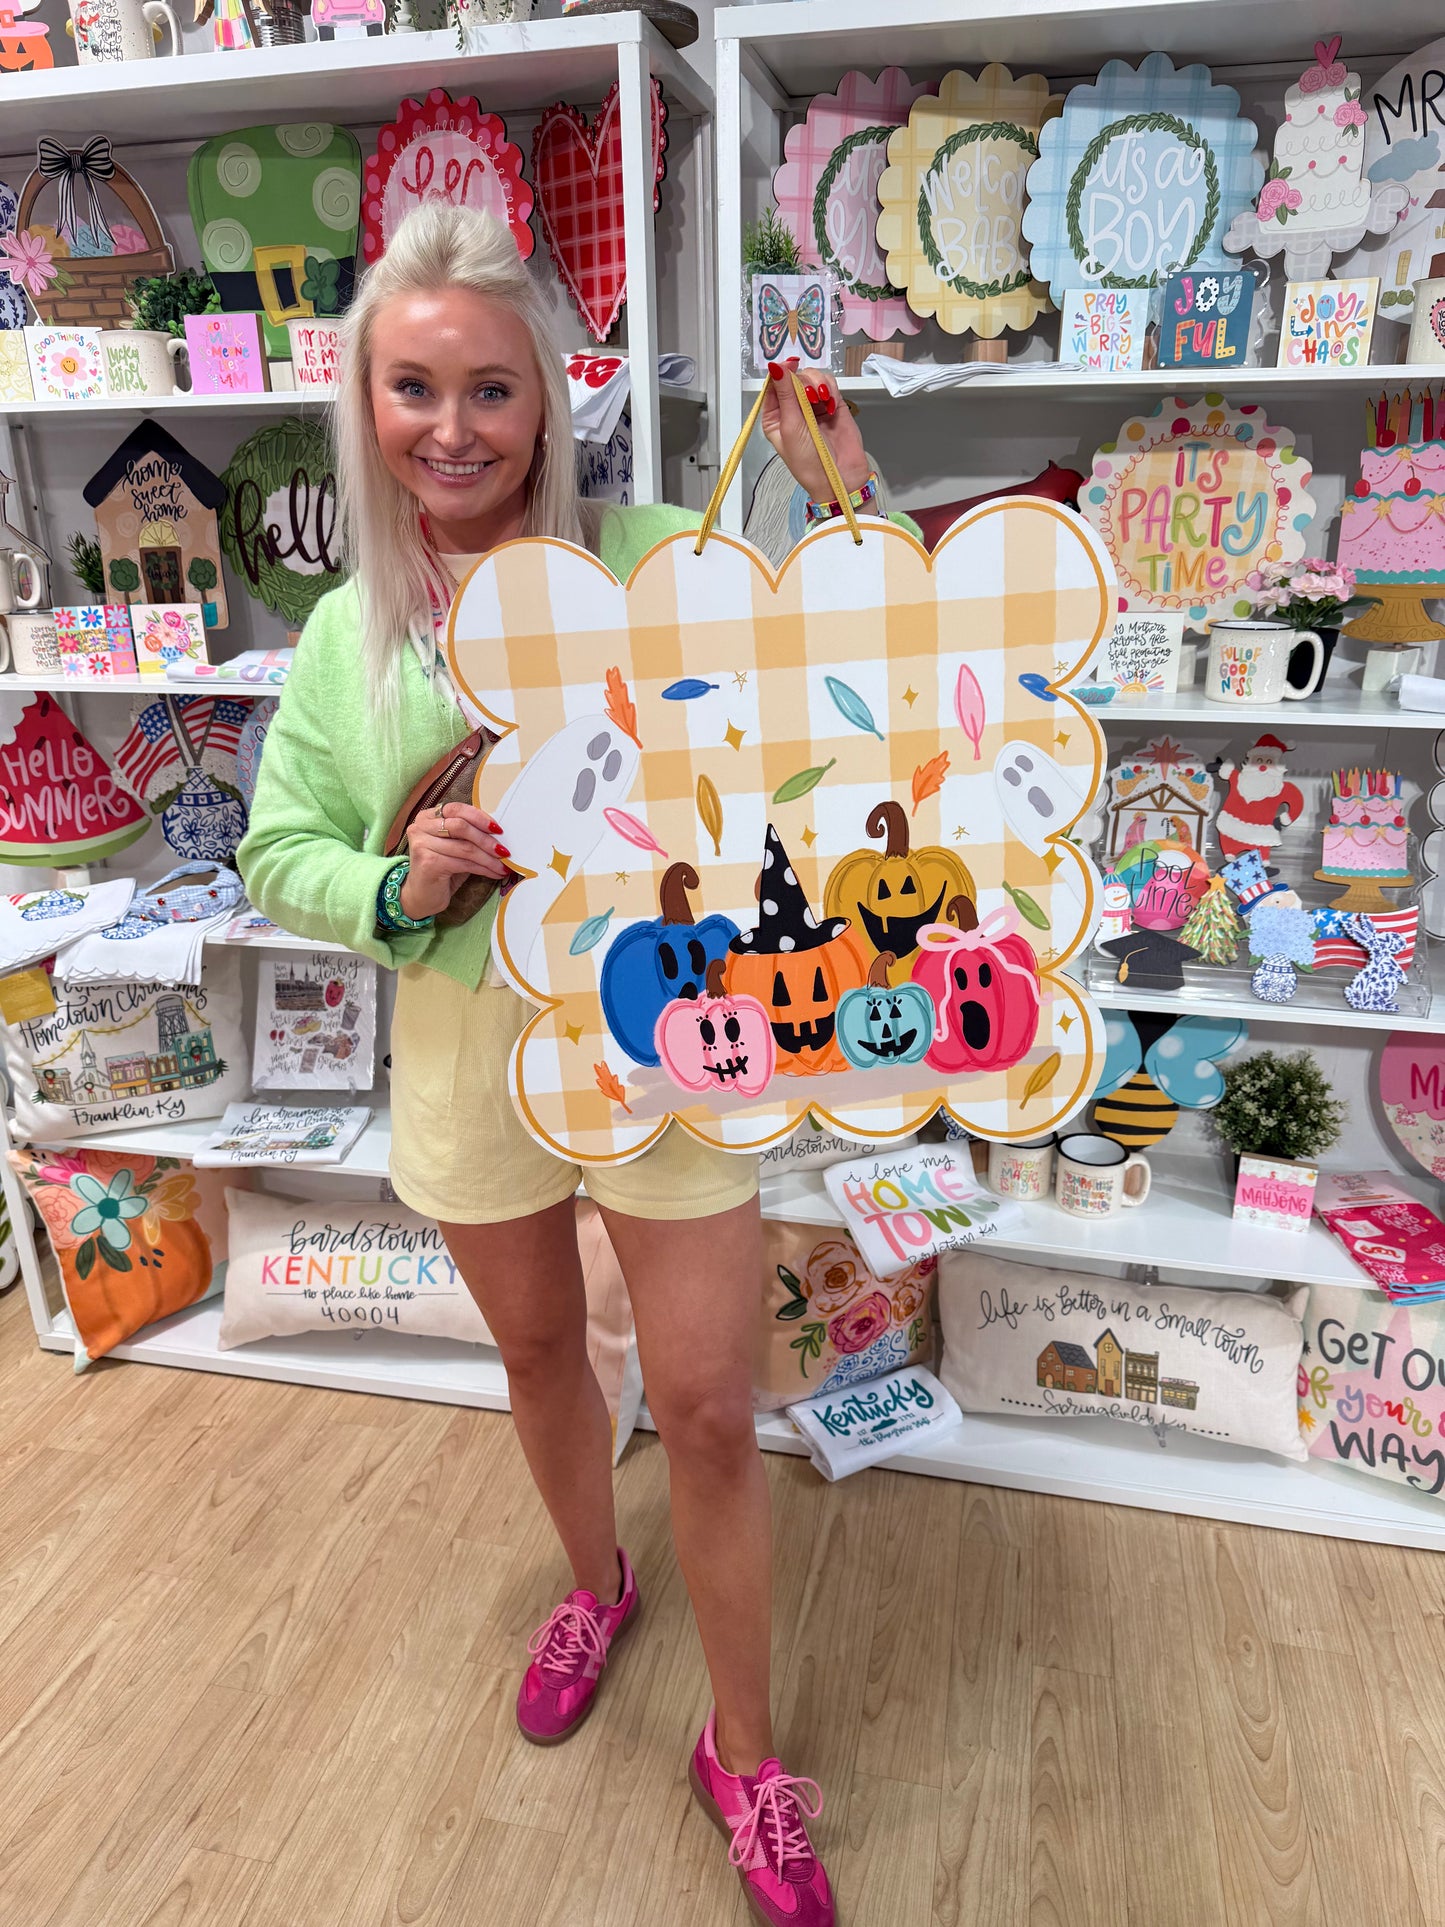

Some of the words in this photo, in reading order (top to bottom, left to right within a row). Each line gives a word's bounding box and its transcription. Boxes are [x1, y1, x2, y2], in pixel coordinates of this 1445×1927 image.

[936, 214, 1032, 281] BAB
[1080, 191, 1197, 281] BOY
[1083, 293, 1128, 314] PRAY
[1174, 275, 1243, 316] JOY
[1300, 291, 1358, 323] JOY
[298, 328, 315, 347] MY
[1072, 332, 1131, 354] WORRY
[1174, 317, 1236, 362] FUL
[1287, 336, 1360, 366] CHAOS
[304, 349, 317, 366] IS
[320, 349, 342, 366] MY
[1079, 353, 1122, 372] SMALL
[81, 382, 102, 399] WAY
[122, 459, 183, 493] home
[131, 481, 185, 511] sweet
[140, 503, 189, 524] home
[1117, 484, 1269, 557] PARTY
[1219, 662, 1258, 680] GOOD
[867, 1162, 914, 1182] love
[919, 1154, 956, 1172] my
[842, 1165, 976, 1215] HOME
[1241, 1187, 1308, 1213] MAHJONG
[863, 1199, 1001, 1262] TOWN
[261, 1254, 458, 1286] KENTUCKY
[303, 1286, 318, 1299] no
[320, 1285, 357, 1305] place
[357, 1285, 381, 1300] like
[382, 1285, 418, 1301] home
[321, 1306, 400, 1326] 40004
[1033, 1294, 1056, 1322] is
[1055, 1285, 1107, 1320] better
[1110, 1299, 1133, 1322] in
[1136, 1304, 1152, 1322] a
[1211, 1323, 1264, 1375] town
[812, 1379, 934, 1437] Kentucky
[1336, 1384, 1433, 1438] your
[1329, 1419, 1445, 1495] WAY
